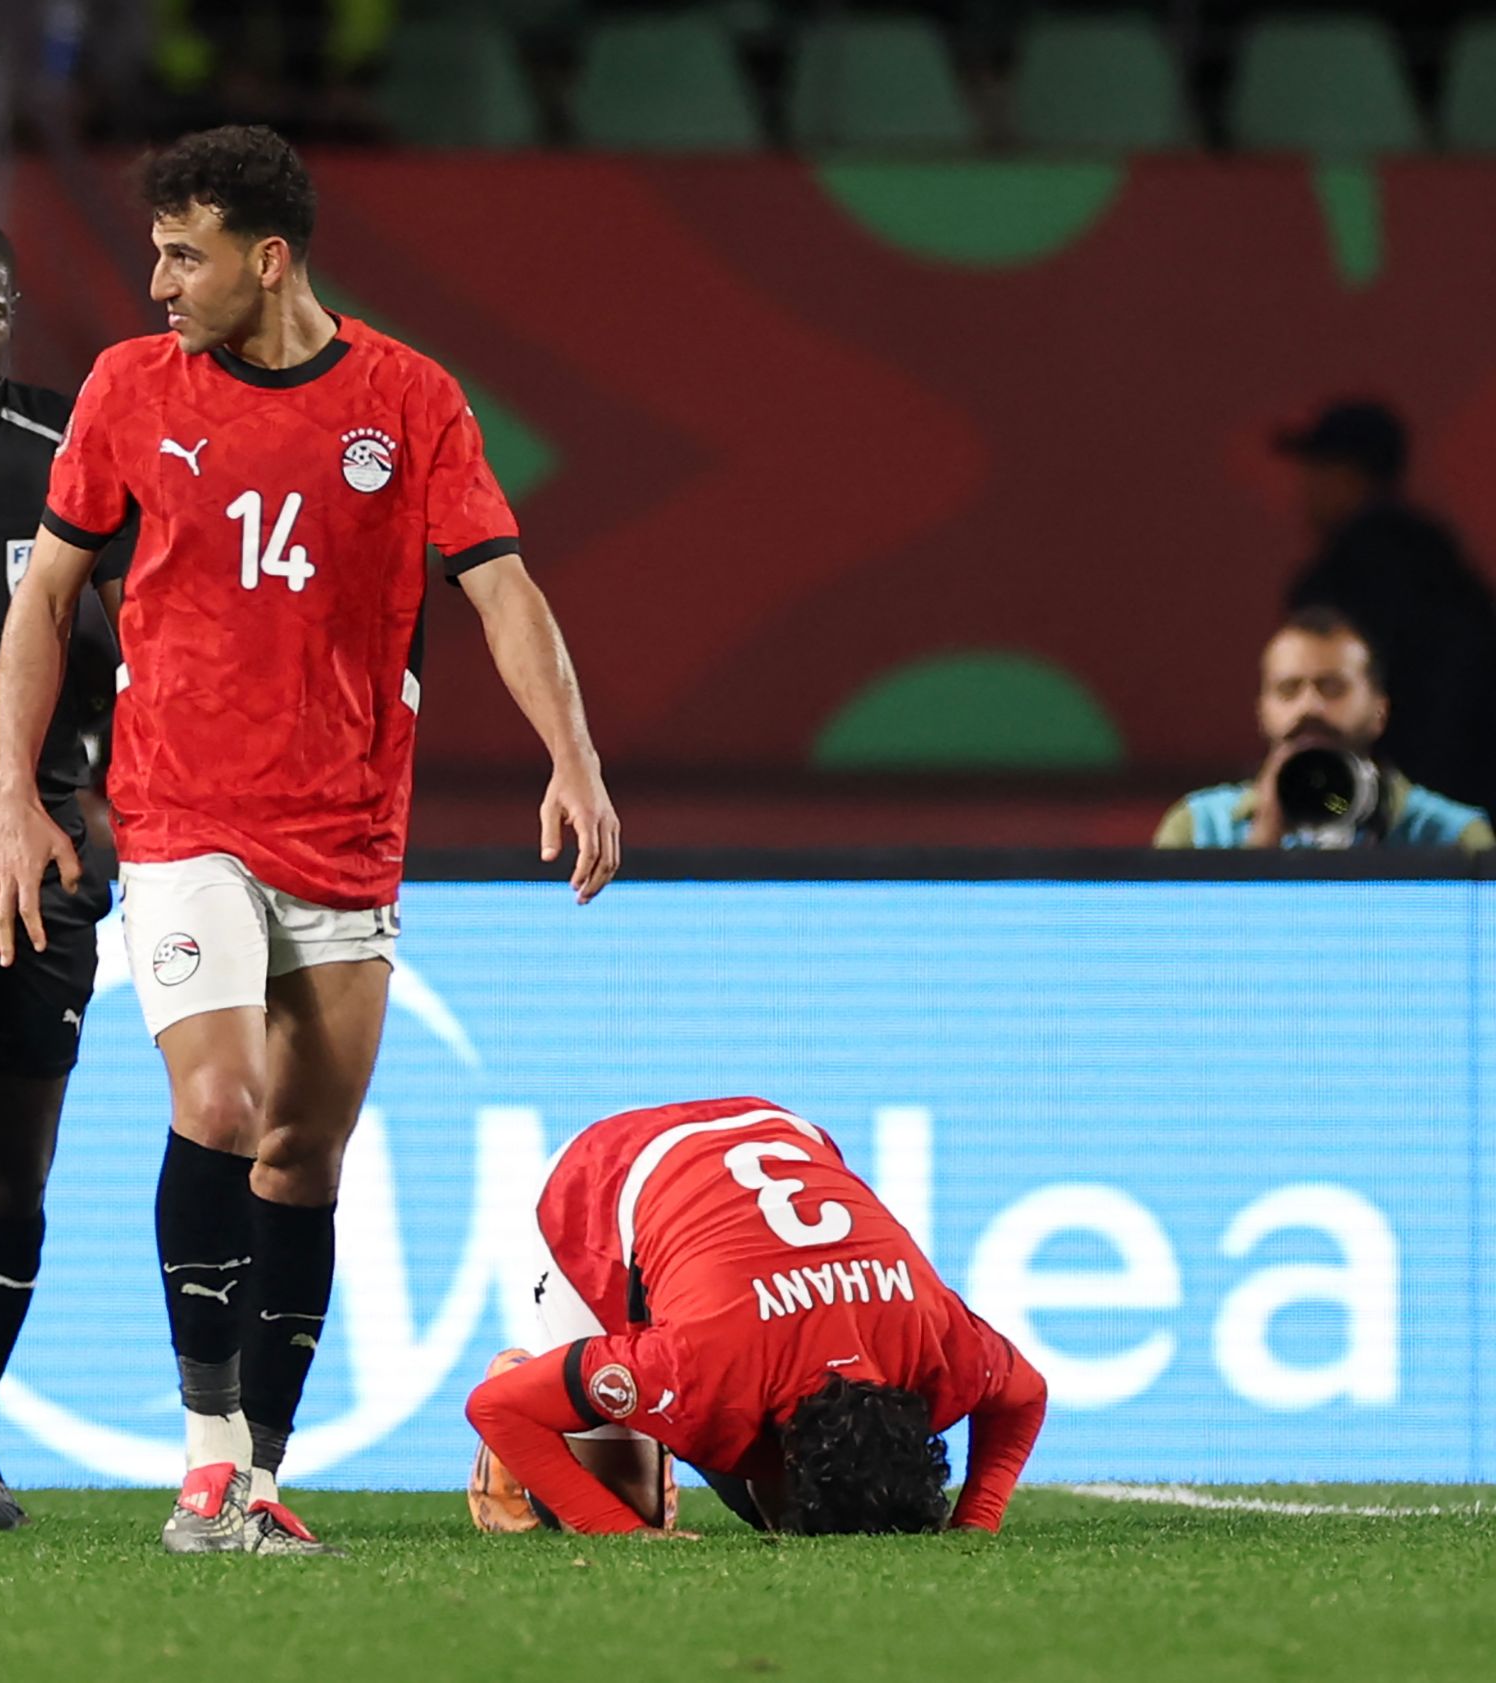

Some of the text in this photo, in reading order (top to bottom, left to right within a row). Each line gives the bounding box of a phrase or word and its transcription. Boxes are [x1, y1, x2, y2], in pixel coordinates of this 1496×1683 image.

[226, 490, 315, 592] 14
[722, 1140, 853, 1248] 3
[752, 1259, 915, 1321] M.HANY
